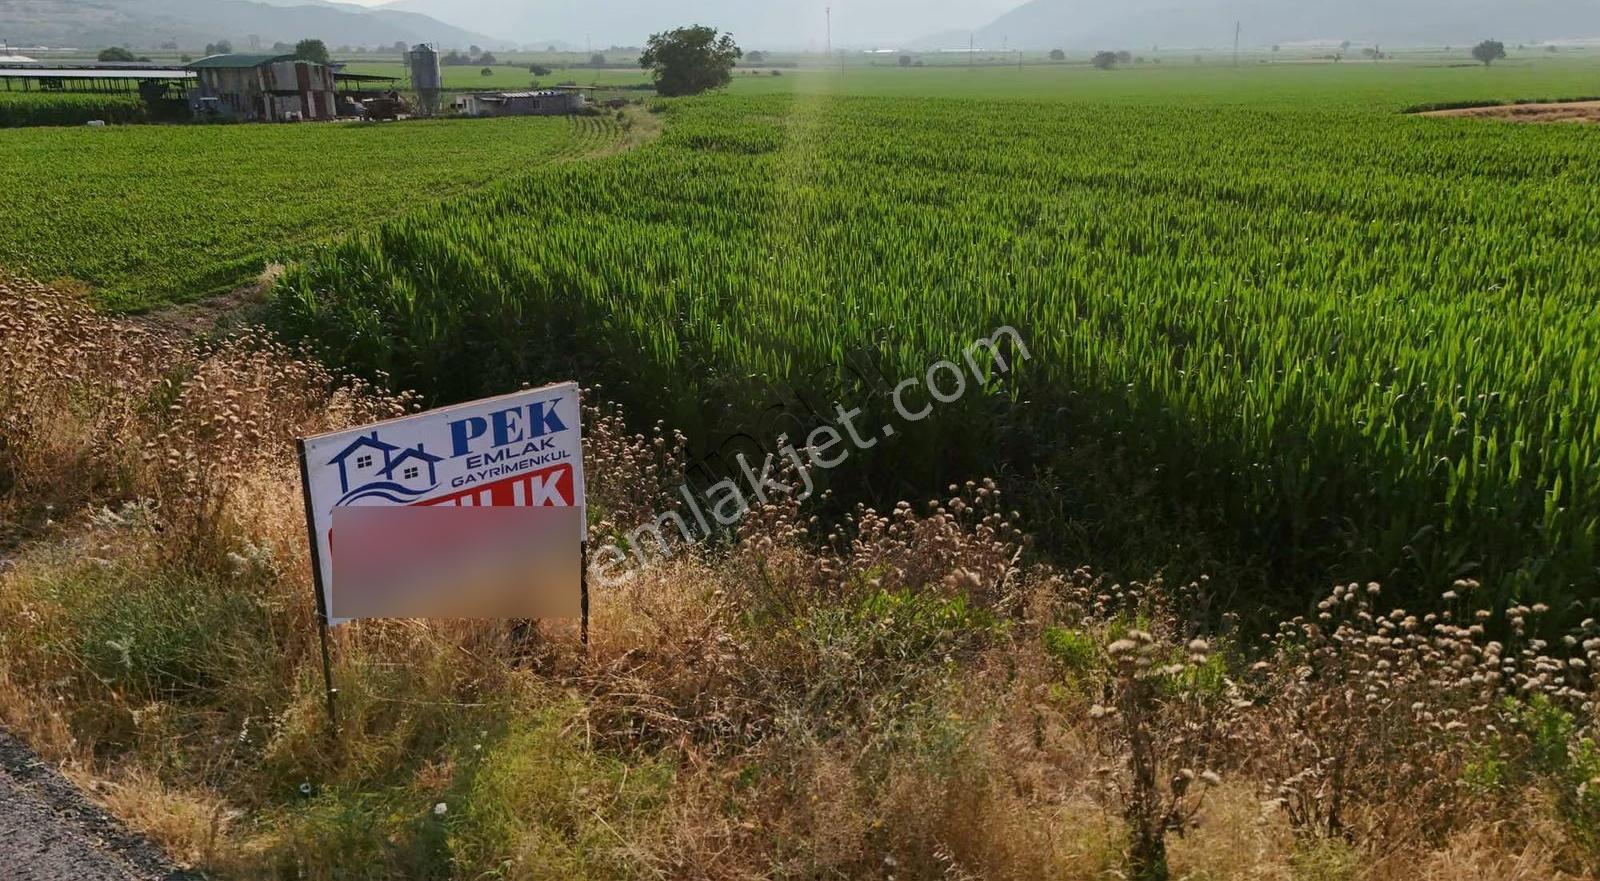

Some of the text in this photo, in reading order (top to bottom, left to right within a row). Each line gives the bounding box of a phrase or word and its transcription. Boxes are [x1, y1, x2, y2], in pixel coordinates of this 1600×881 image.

[447, 397, 569, 458] PEK
[451, 450, 571, 488] GAYRİMENKUL
[466, 436, 555, 470] EMLAK
